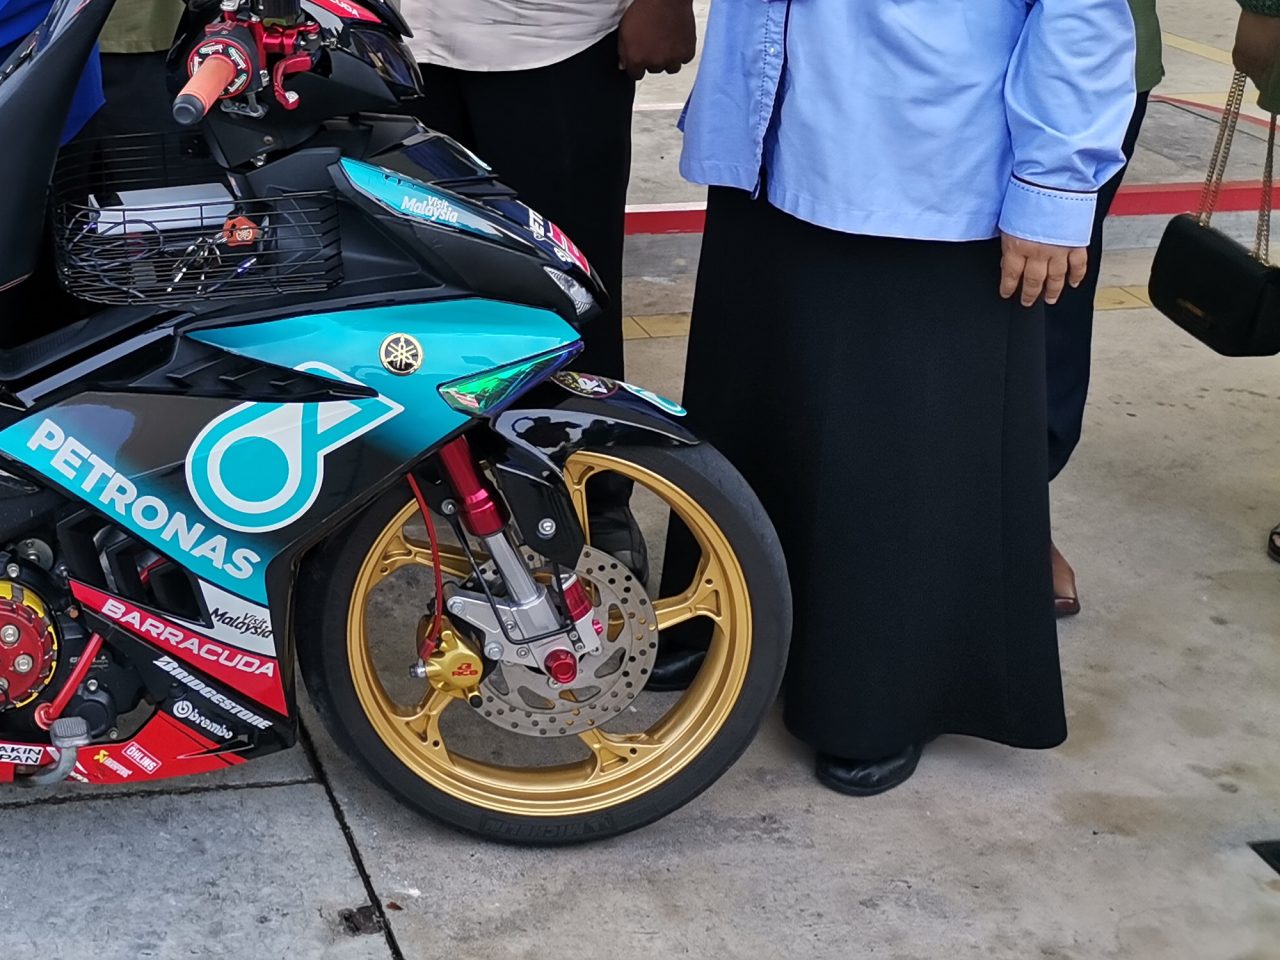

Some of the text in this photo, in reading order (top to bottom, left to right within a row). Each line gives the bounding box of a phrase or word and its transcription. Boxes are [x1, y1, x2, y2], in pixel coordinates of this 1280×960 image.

[400, 195, 458, 223] Malaysia
[428, 195, 449, 209] Visit
[26, 418, 261, 579] PETRONAS
[210, 607, 273, 639] Malaysia
[241, 612, 267, 627] Visit
[101, 598, 275, 678] BARRACUDA
[152, 655, 273, 730] BRIDGESTONE
[188, 708, 234, 739] brembo
